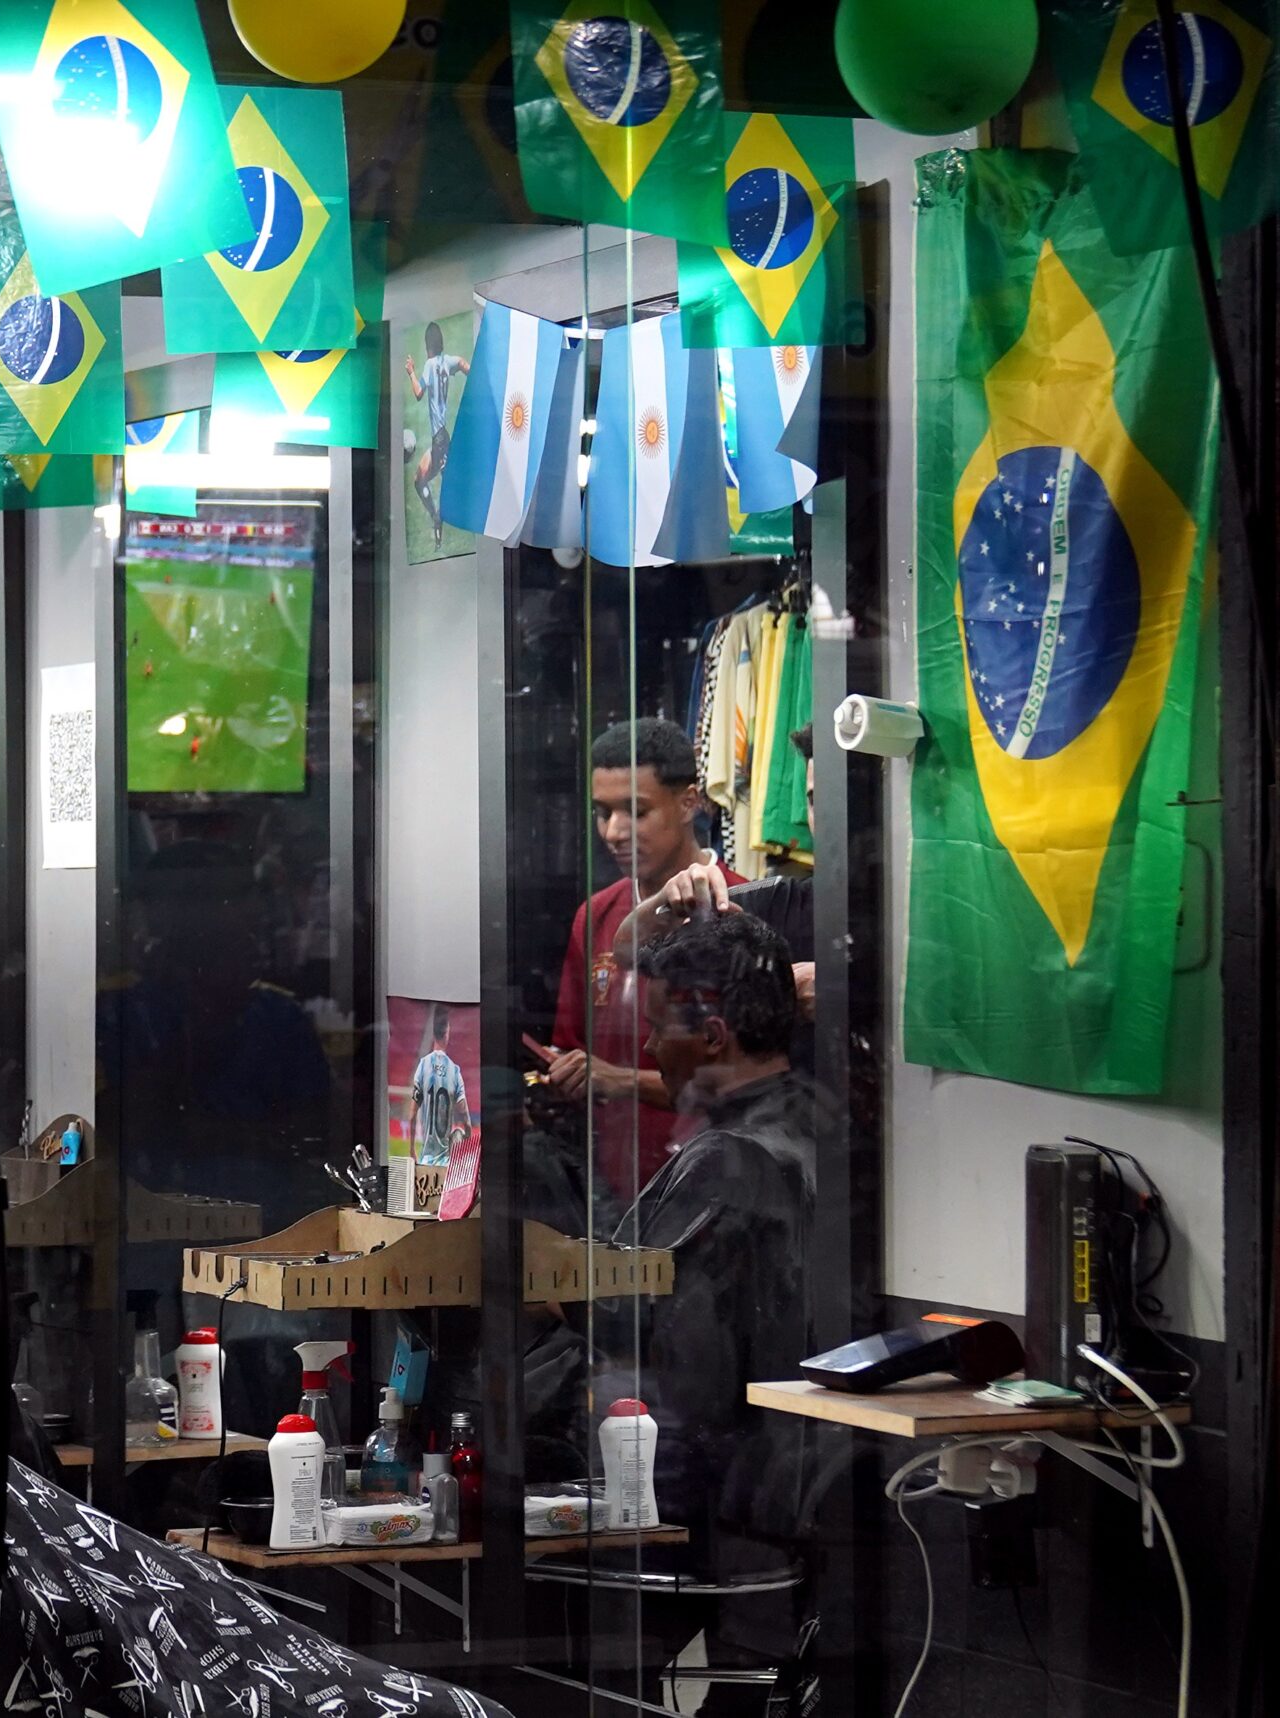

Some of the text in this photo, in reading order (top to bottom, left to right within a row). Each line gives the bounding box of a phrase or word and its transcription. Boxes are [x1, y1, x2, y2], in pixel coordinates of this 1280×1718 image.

[1019, 467, 1070, 739] ORDEM E PROGRESSO
[427, 1085, 451, 1138] 10
[63, 1569, 89, 1608] SHOP
[199, 1644, 226, 1668] SHOP
[203, 1651, 241, 1681] BARBER
[285, 1643, 318, 1673] SHOP
[286, 1633, 331, 1677] BARBER
